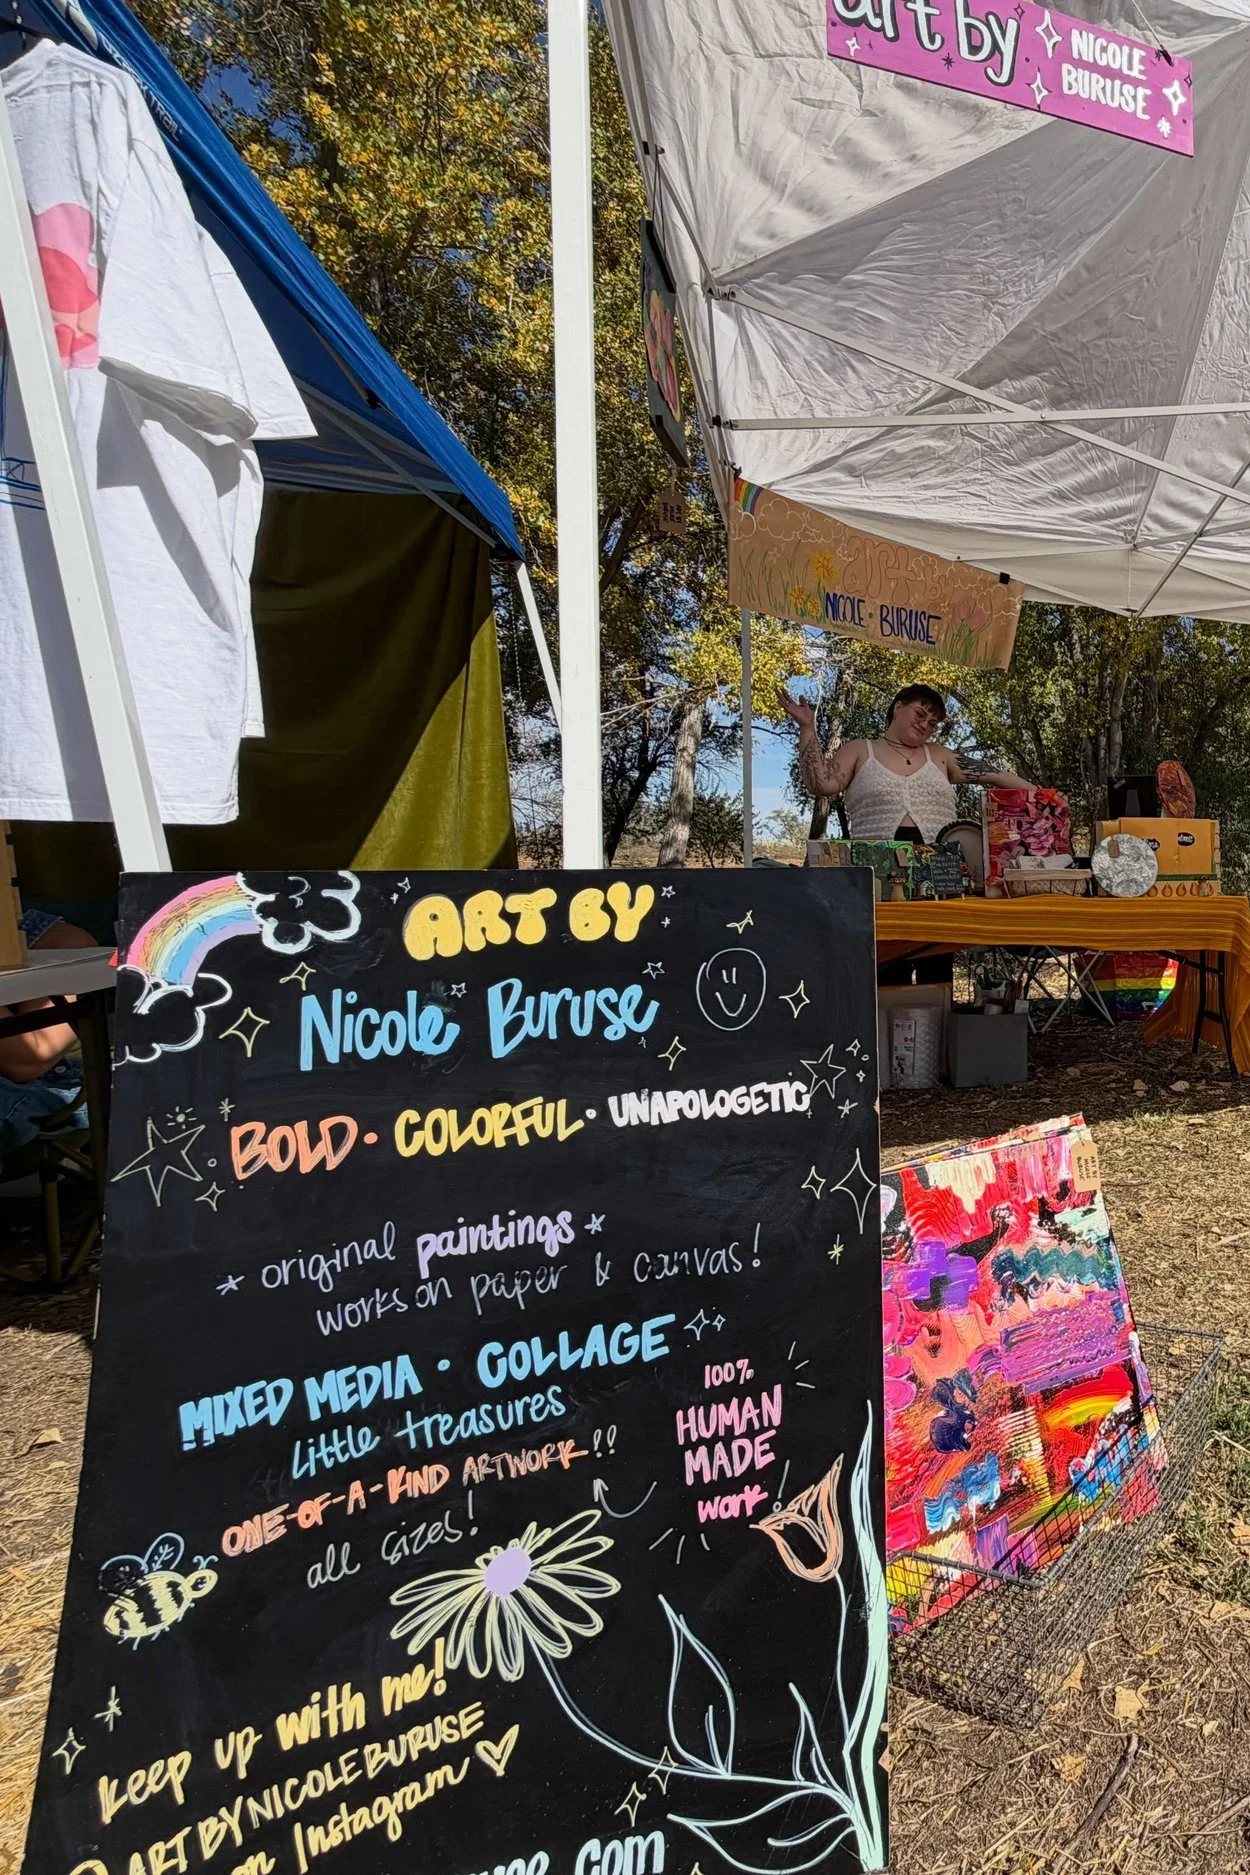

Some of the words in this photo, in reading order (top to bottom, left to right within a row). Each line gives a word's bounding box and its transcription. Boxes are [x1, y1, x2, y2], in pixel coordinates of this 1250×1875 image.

[954, 0, 1019, 86] by
[1070, 28, 1147, 81] NICOLE
[1061, 63, 1151, 121] BURUSE
[843, 535, 917, 606] art
[825, 591, 866, 628] NICOLE
[880, 604, 942, 645] BURUSE
[404, 887, 556, 962] ART
[568, 881, 655, 942] BY
[299, 990, 459, 1070] Nicole
[488, 978, 660, 1058] Buruse
[231, 1116, 356, 1179] BOLD
[395, 1098, 585, 1157] COLORFUL
[608, 1079, 810, 1128] UNAPOLOGETIC
[261, 1223, 399, 1293] original
[415, 1208, 576, 1278] paintings
[317, 1290, 409, 1337] works
[414, 1274, 452, 1309] on
[470, 1264, 568, 1316] paper
[633, 1222, 763, 1284] canvas!
[177, 1377, 293, 1451] MIXED
[306, 1354, 421, 1422] MEDIA
[477, 1314, 677, 1388] COLLAGE
[676, 1387, 783, 1442] HUMAN
[703, 1357, 755, 1388] 100%
[393, 1384, 566, 1450] treasures
[685, 1431, 776, 1486] MADE
[221, 1463, 450, 1557] ONE-OF-A-KIND
[307, 1541, 361, 1589] all
[381, 1489, 479, 1566] sizes!
[214, 1724, 264, 1780] up
[276, 1684, 367, 1751] with
[382, 1638, 448, 1714] me!
[294, 1756, 471, 1864] Instagram
